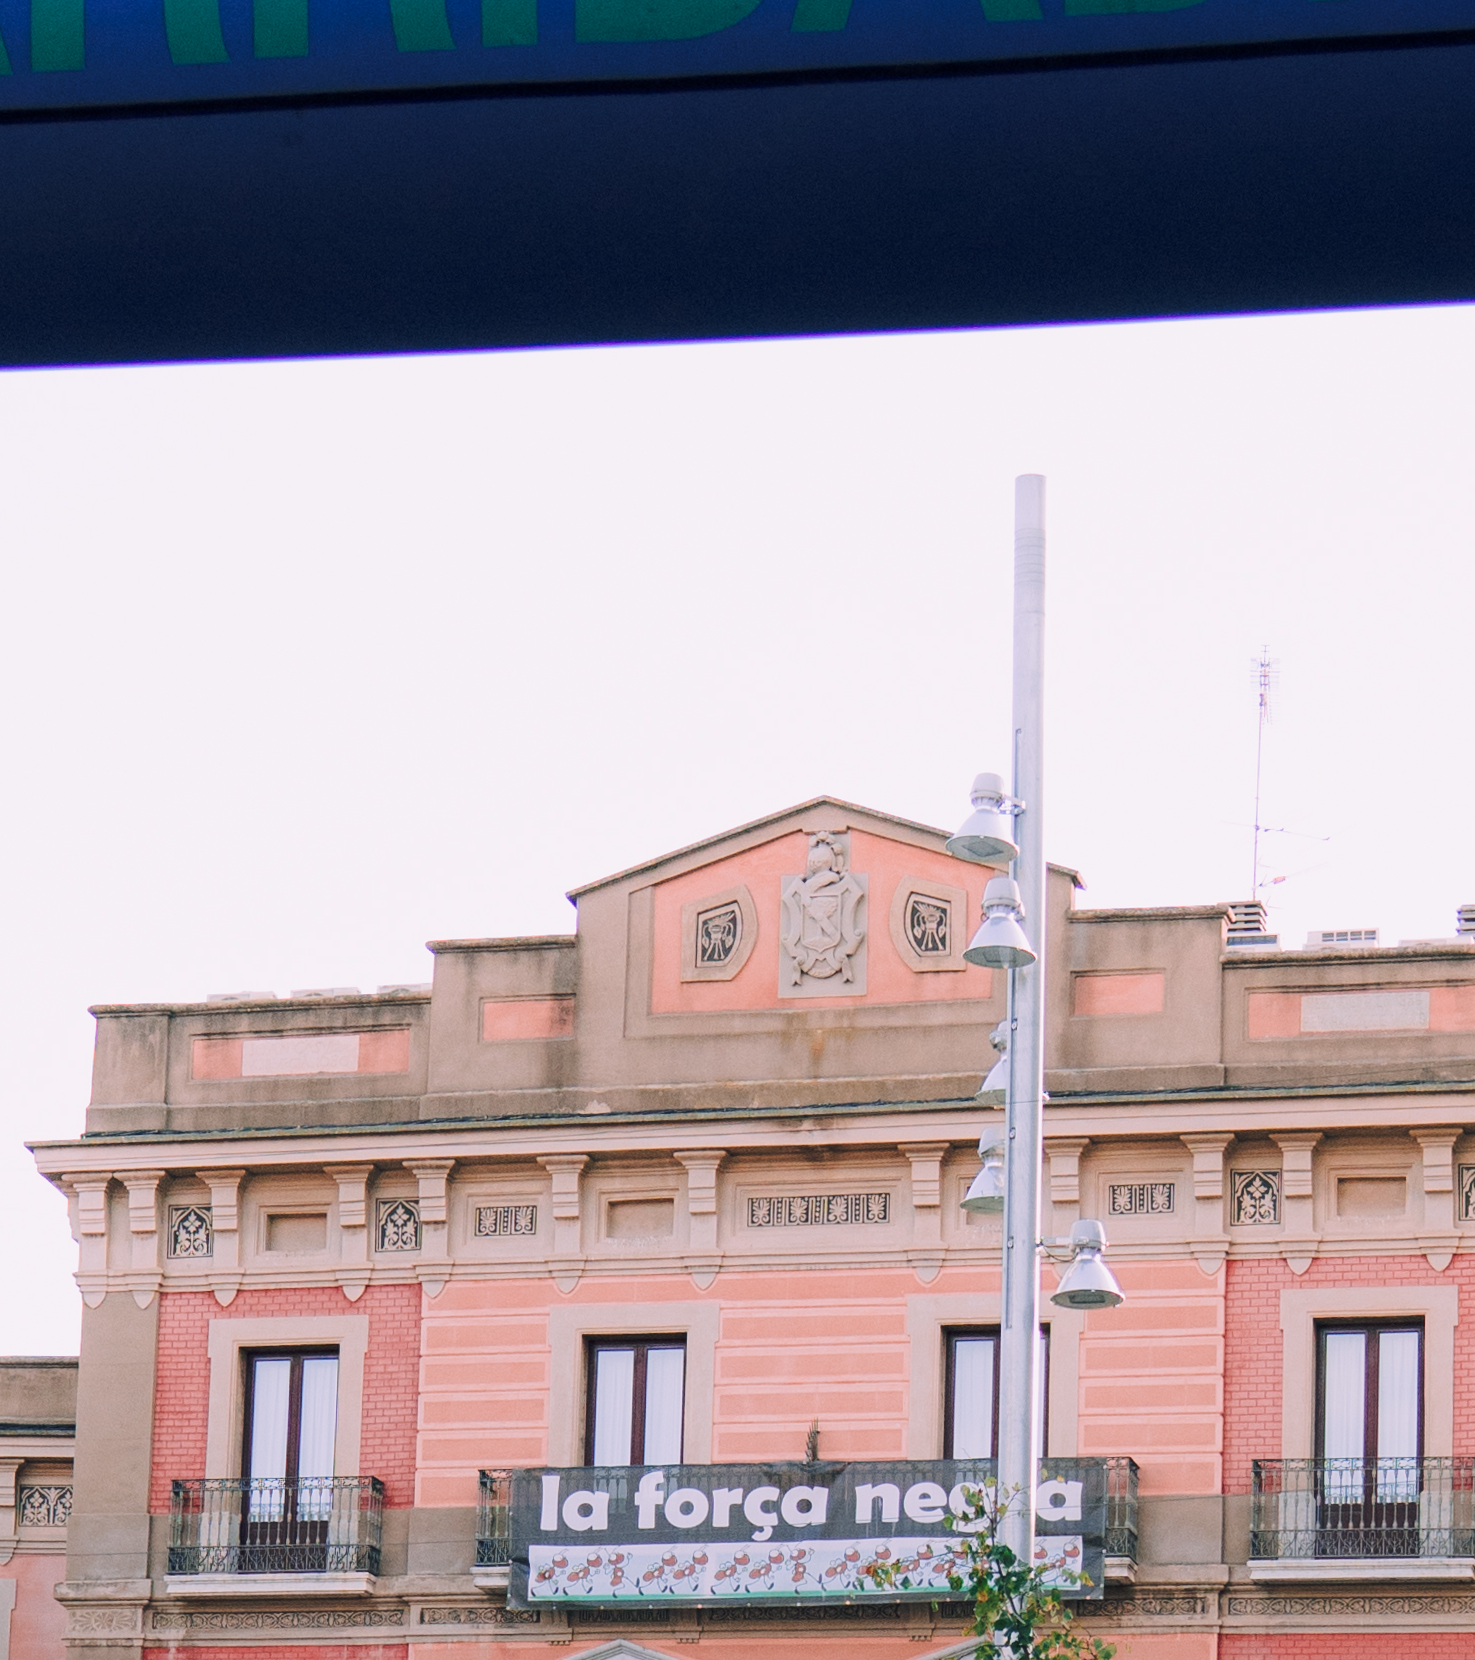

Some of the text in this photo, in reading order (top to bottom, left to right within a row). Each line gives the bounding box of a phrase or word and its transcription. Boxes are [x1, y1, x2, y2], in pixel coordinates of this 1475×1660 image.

[540, 1471, 1084, 1541] la força nega
